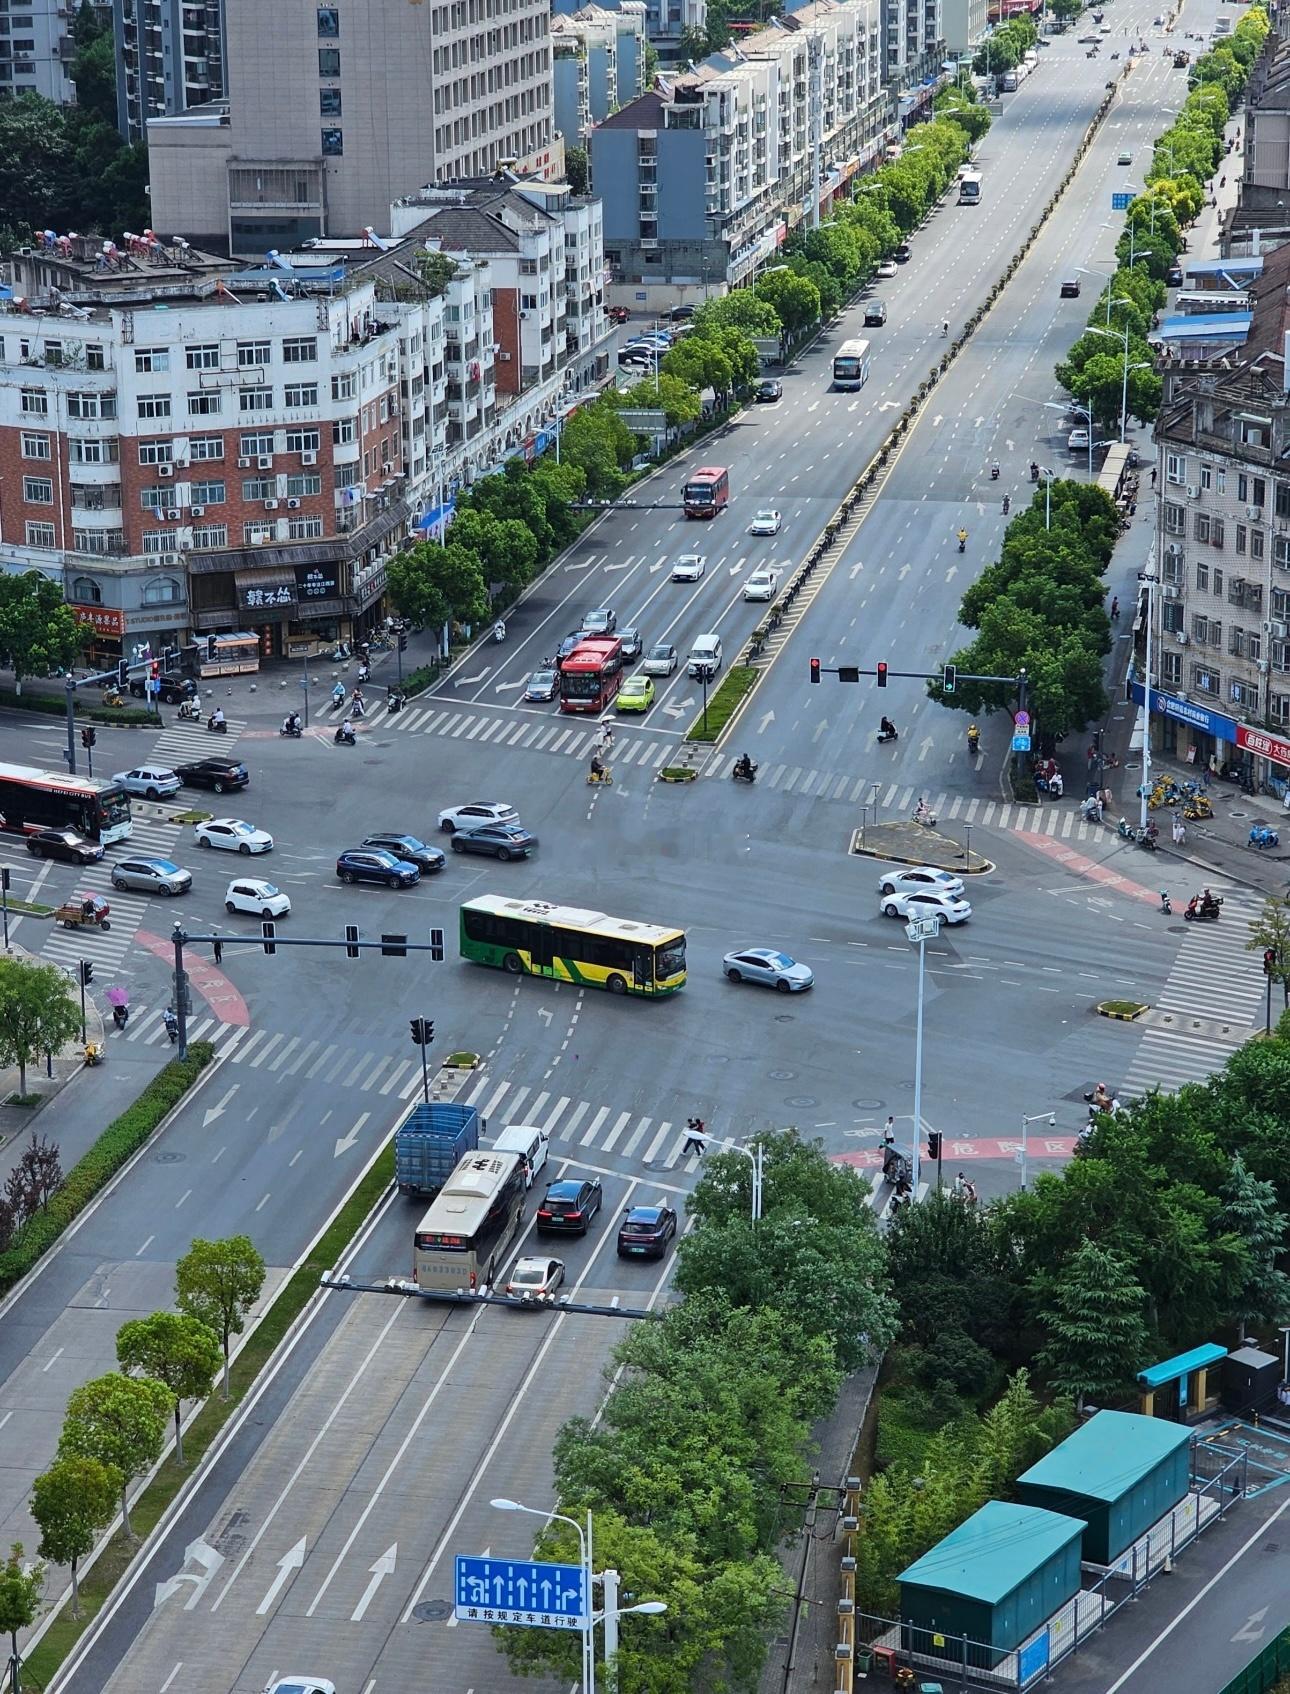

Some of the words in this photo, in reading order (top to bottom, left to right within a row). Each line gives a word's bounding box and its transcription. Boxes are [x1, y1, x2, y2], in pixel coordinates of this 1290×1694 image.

[246, 586, 291, 606] 赣不怂
[860, 1141, 1069, 1164] 右危险区
[466, 1607, 578, 1627] 请按规定车道行驶
